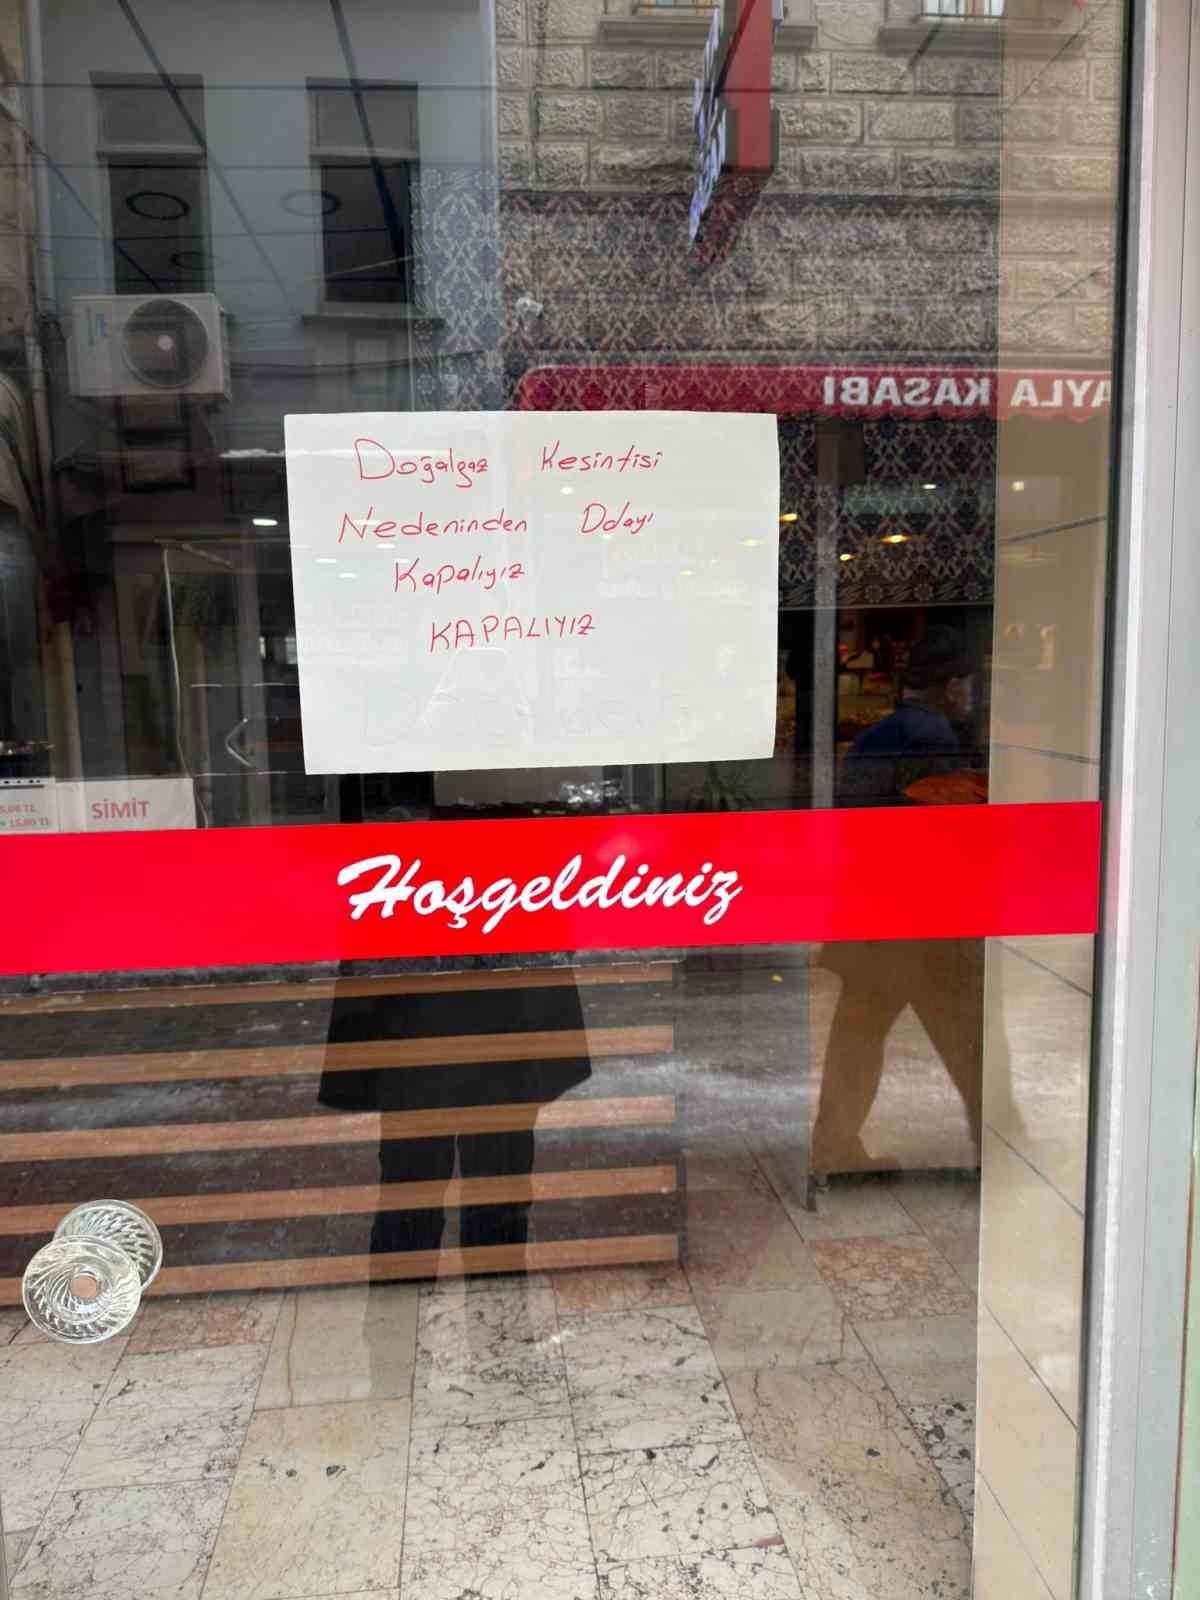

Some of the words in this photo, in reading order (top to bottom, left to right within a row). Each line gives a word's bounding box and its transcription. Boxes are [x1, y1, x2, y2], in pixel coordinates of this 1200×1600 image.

[354, 438, 488, 488] Doğalgaz
[540, 439, 663, 473] Kesintisi
[337, 506, 528, 543] Nedeninden
[430, 613, 596, 653] KAPALIYIZ
[91, 797, 150, 820] SİMİT
[337, 854, 743, 934] Hoşgeldiniz
